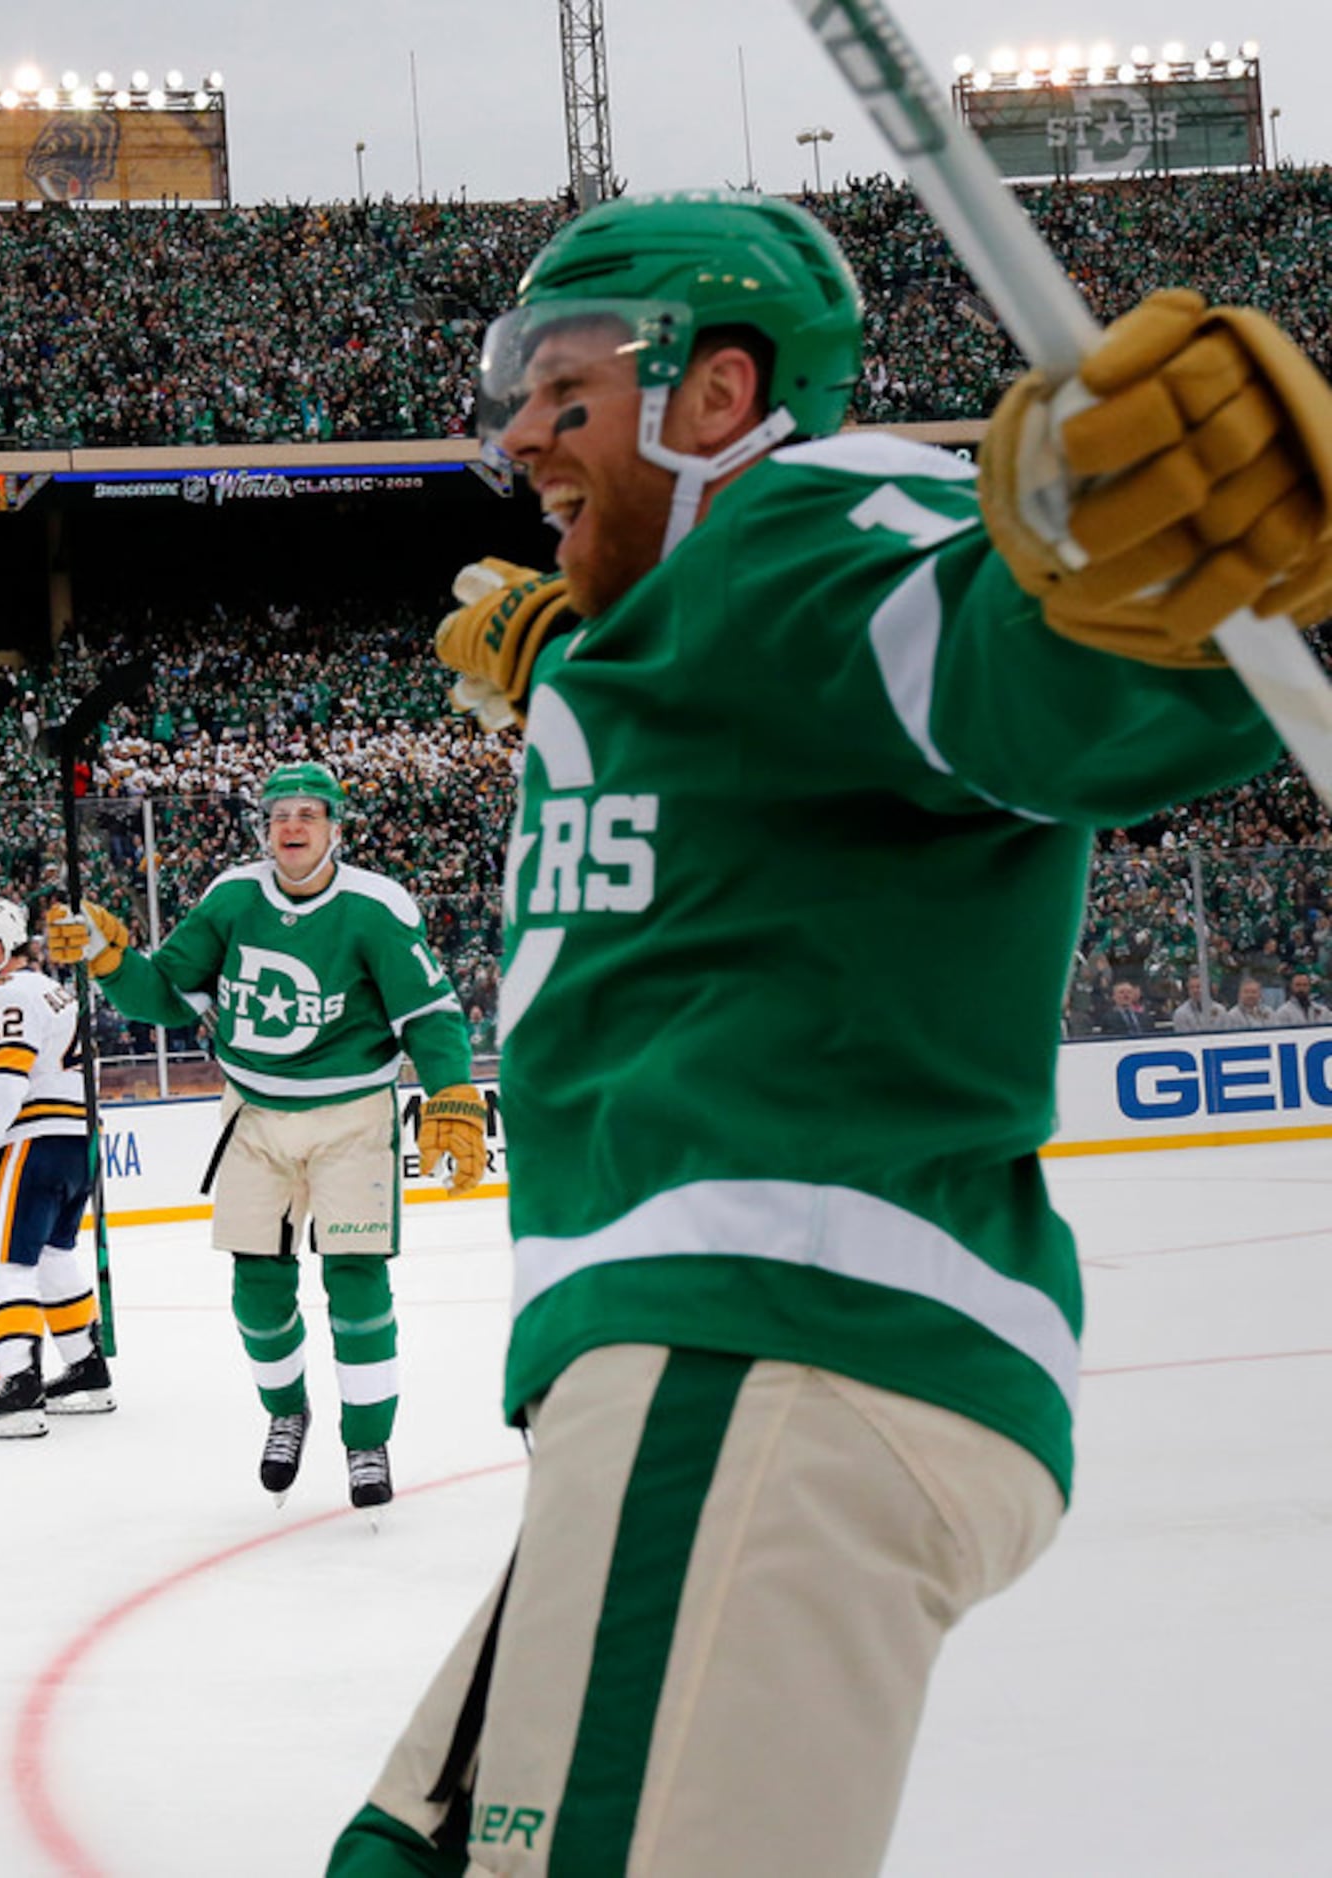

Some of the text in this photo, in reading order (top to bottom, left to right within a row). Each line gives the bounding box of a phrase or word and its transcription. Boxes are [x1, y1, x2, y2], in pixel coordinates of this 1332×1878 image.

[209, 470, 295, 505] Winter
[292, 477, 372, 493] CLASSIC
[385, 477, 424, 490] 2020
